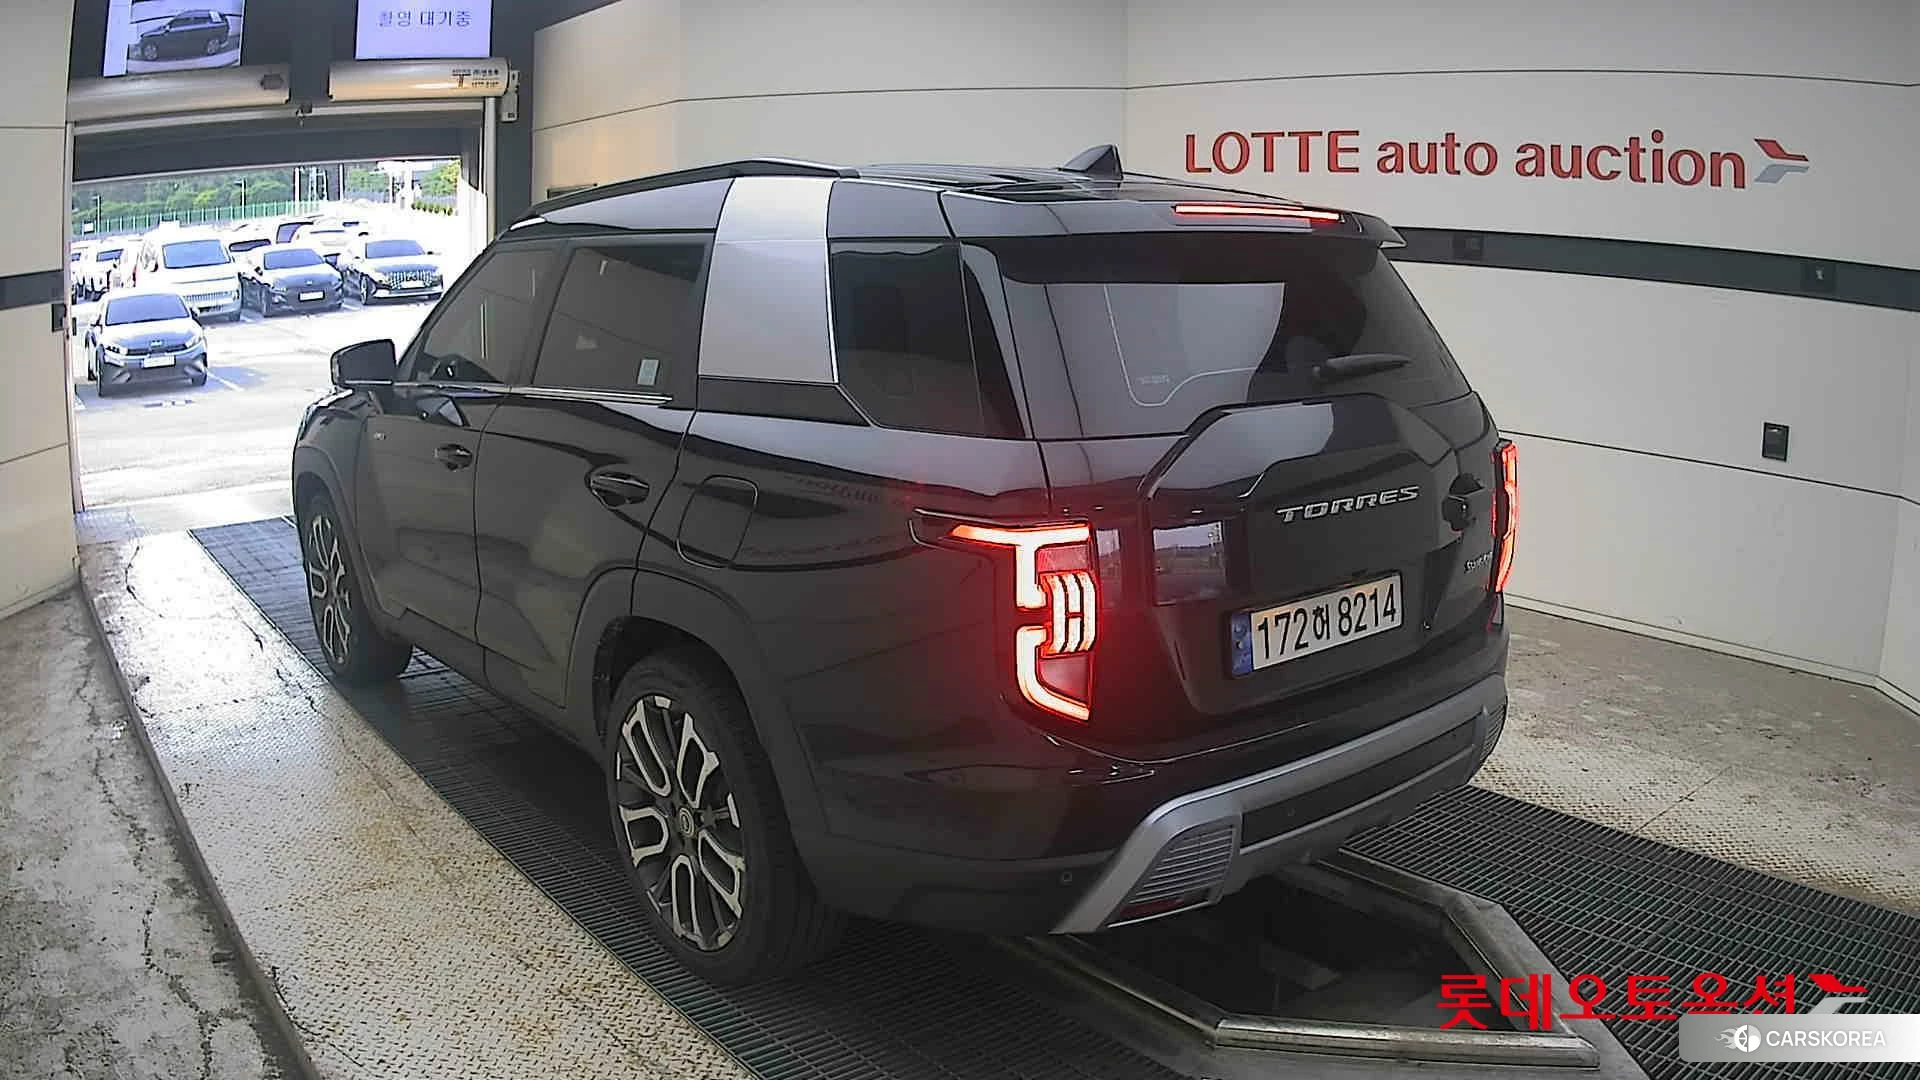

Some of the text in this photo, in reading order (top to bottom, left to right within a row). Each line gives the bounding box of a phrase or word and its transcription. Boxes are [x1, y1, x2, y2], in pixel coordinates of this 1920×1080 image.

[420, 11, 472, 27] 대기중
[1185, 130, 1748, 189] LOTTE auto auction
[1276, 485, 1420, 523] TORRES
[1257, 583, 1396, 659] 172허 8214
